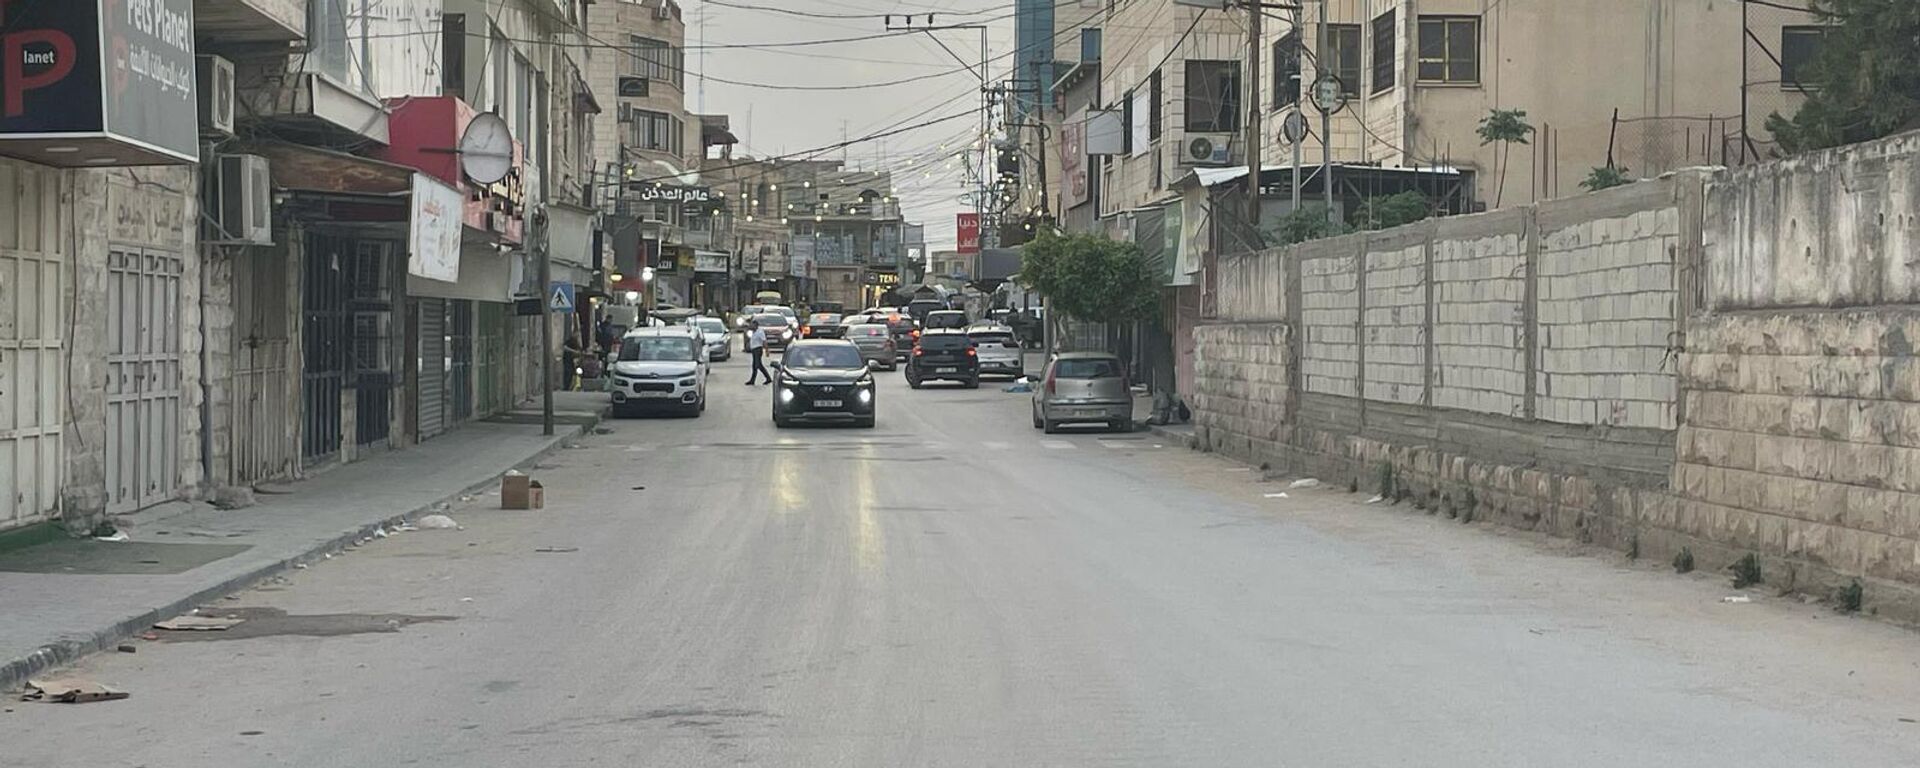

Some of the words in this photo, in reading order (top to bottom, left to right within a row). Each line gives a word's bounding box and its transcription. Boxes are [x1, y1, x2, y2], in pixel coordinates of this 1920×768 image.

[127, 0, 153, 35] Pets
[154, 0, 189, 53] Planet
[641, 187, 682, 201] المدخن
[681, 189, 709, 203] عالم
